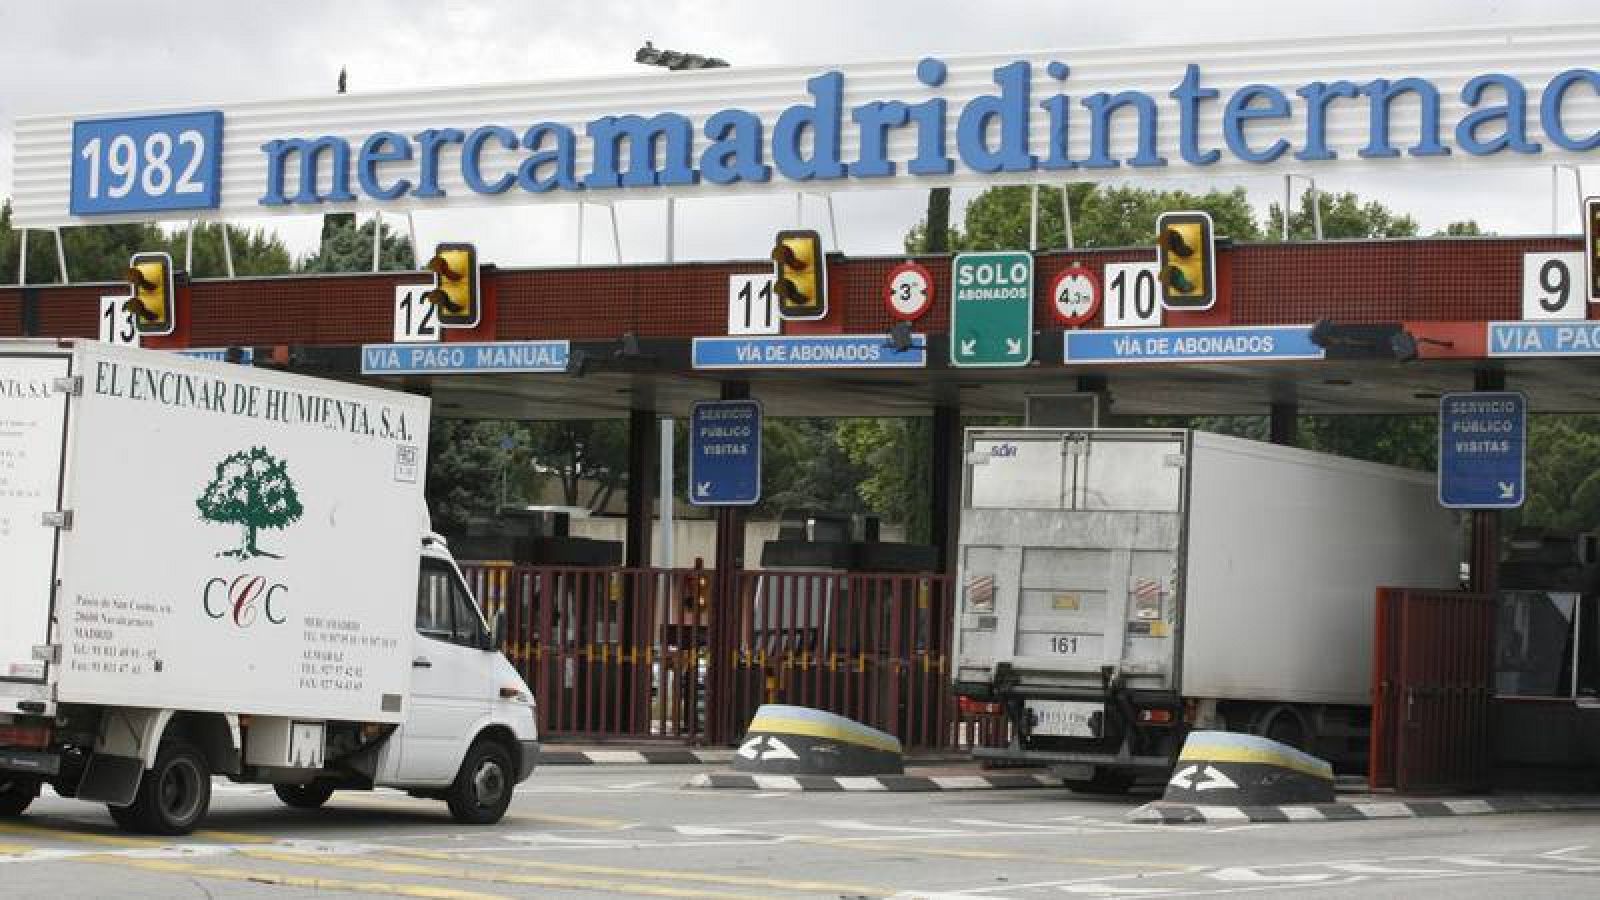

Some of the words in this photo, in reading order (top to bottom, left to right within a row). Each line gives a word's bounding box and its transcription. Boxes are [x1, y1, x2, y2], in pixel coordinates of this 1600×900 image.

[81, 130, 205, 199] 1982
[959, 262, 1027, 285] SOLO
[959, 288, 1027, 300] ABONADOS
[1110, 269, 1156, 320] 10
[1539, 259, 1571, 313] 9
[399, 291, 436, 336] 12
[738, 280, 772, 328] 11
[104, 301, 136, 342] 13
[1113, 335, 1141, 355] VÍA
[1146, 338, 1169, 354] DE
[1174, 336, 1274, 353] ABONADOS
[1495, 328, 1542, 350] VIA
[367, 350, 400, 369] VIA
[411, 348, 465, 368] PAGO
[477, 347, 563, 367] MANUAL
[736, 344, 759, 361] VÍA
[766, 345, 786, 361] DE
[790, 345, 881, 361] ABONADOS
[96, 361, 122, 398] EL
[130, 367, 227, 413] ENCINAR
[232, 384, 260, 418] DE
[266, 389, 375, 436] HUMIENTA,
[380, 407, 413, 441] S.A.
[1451, 401, 1515, 414] SERVICIO
[701, 410, 752, 420] SERVICIO
[704, 444, 748, 455] VISITAS
[1456, 440, 1510, 453] VISITAS
[1051, 637, 1078, 654] 161
